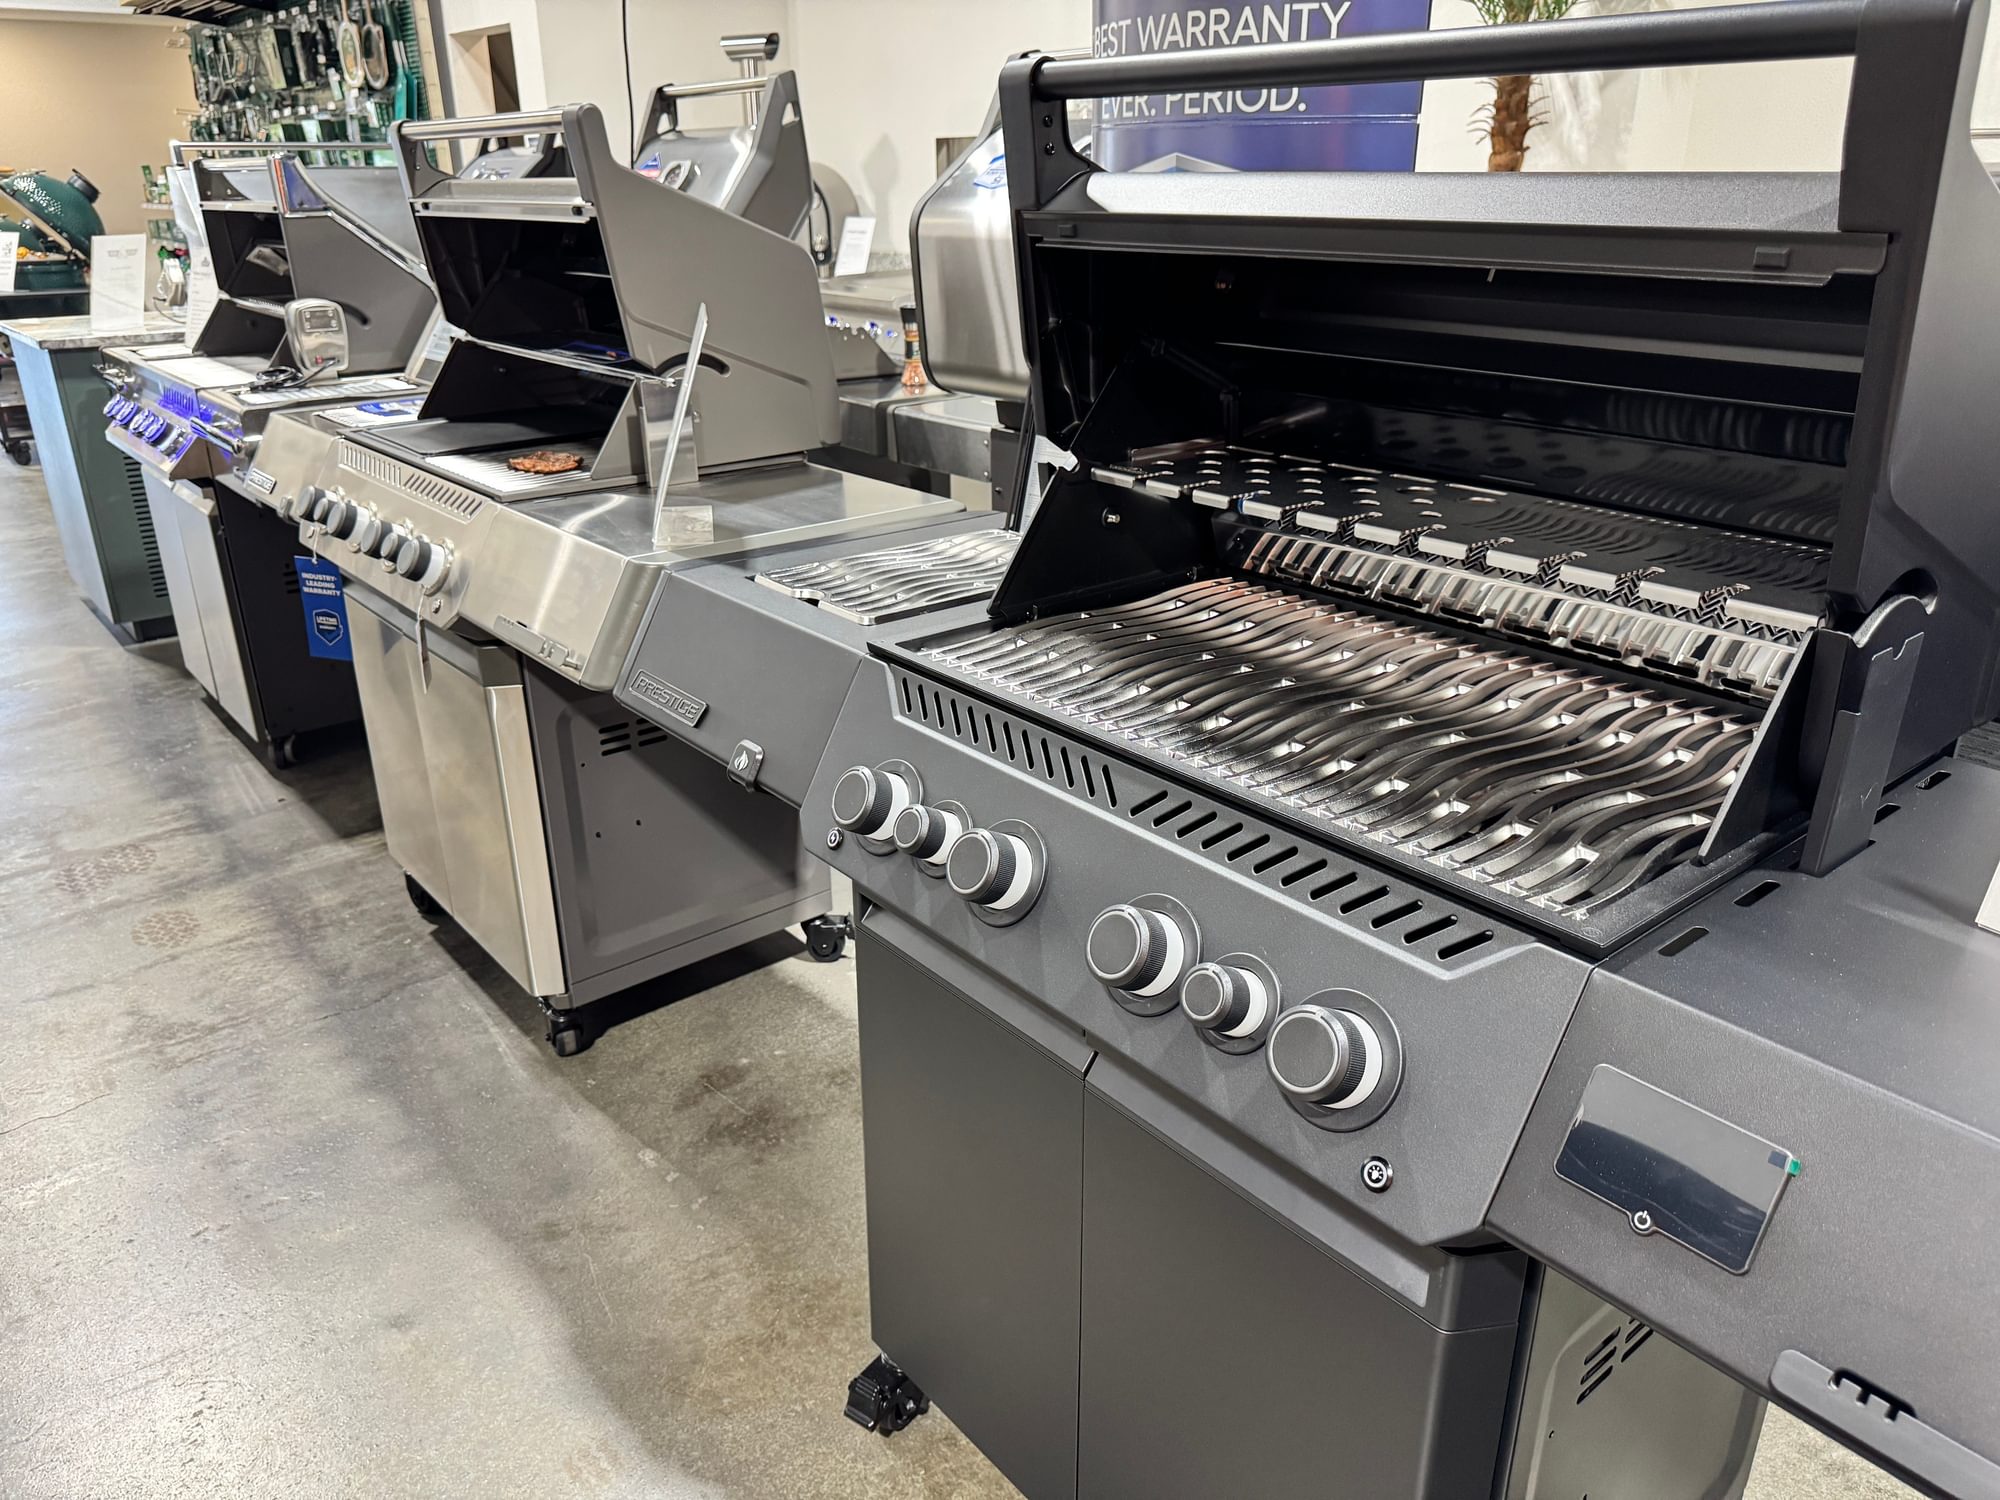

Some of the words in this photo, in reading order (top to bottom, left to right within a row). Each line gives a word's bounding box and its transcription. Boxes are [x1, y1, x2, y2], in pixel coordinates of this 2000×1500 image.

[1094, 18, 1132, 58] BEST
[1137, 1, 1351, 52] WARRANTY
[1101, 95, 1156, 120] EVER.
[1165, 87, 1307, 115] PERIOD.
[302, 586, 341, 596] WARRANTY
[305, 580, 336, 589] LEADING
[636, 677, 699, 718] PRESTIGE
